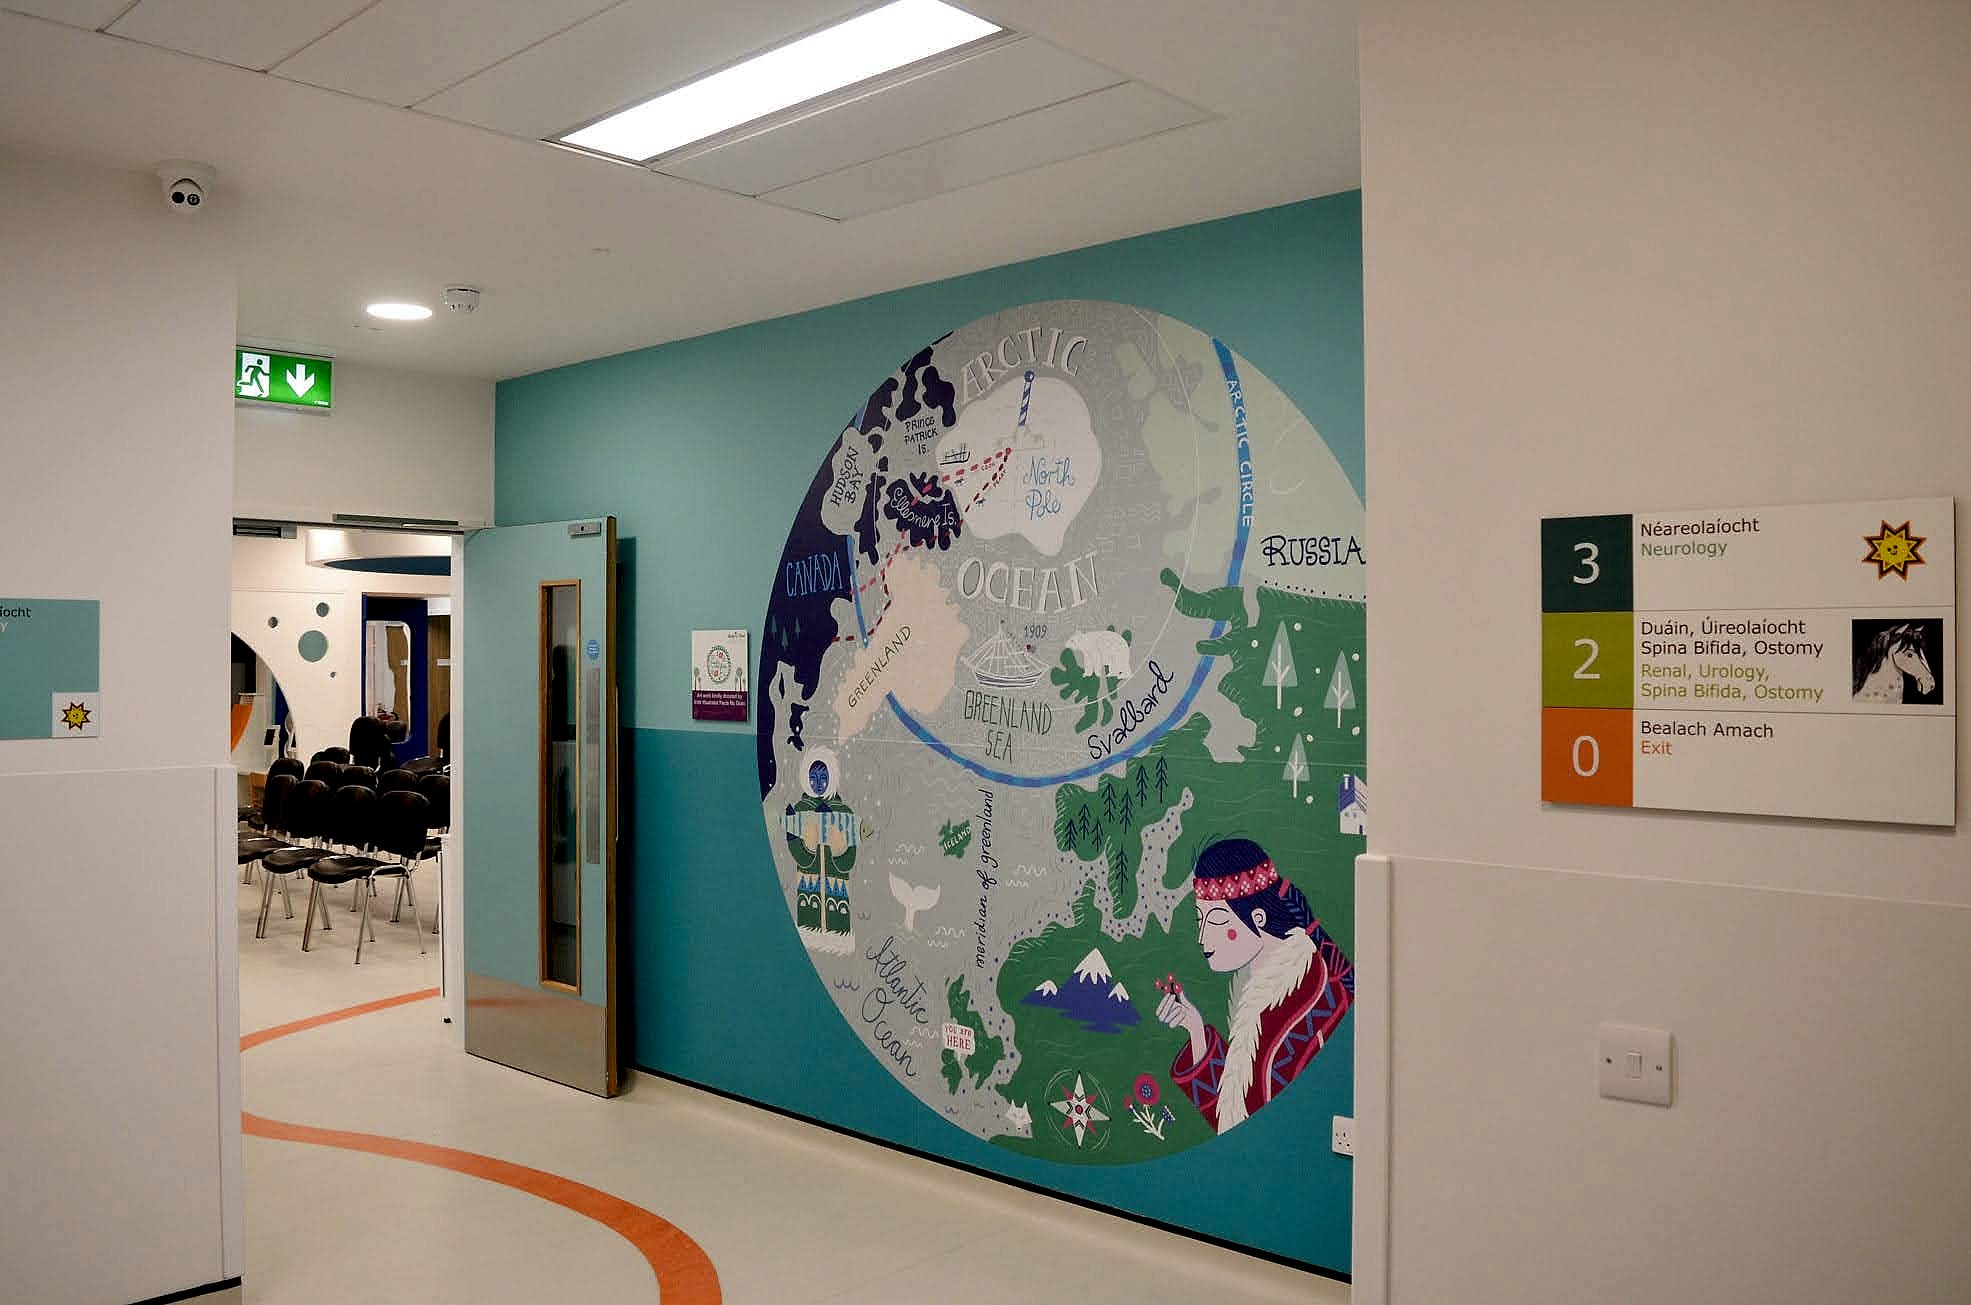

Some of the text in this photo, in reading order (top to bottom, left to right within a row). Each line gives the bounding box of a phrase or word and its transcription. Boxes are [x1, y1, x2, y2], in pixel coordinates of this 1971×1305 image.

[958, 326, 1089, 403] ARCTIC
[904, 427, 939, 445] PATRICK
[905, 416, 935, 432] PRINCE
[1227, 380, 1256, 527] ARCTIC CIRCLE
[831, 446, 860, 507] HUDSON
[844, 464, 864, 504] BAY
[1022, 456, 1075, 488] North
[1025, 488, 1062, 520] Pole
[1640, 518, 1761, 537] Néareolaíocht
[1261, 534, 1366, 566] RUSSIA
[1572, 542, 1600, 585] 3
[1640, 541, 1728, 557] Neurology
[785, 551, 844, 596] CANADA
[957, 552, 1100, 614] OCEAN
[1024, 624, 1048, 641] 1909
[1641, 617, 1806, 637] Duáin, Úireolaíocht
[1572, 638, 1601, 680] 2
[1641, 640, 1824, 657] Spina Bifida, Ostomy
[847, 624, 914, 709] GREENLAND
[1641, 664, 1770, 682] Renal, Urology,
[1641, 684, 1824, 702] Spina Bifida, Ostomy
[964, 689, 1053, 737] GREENLAND
[1087, 660, 1175, 761] Svalbard
[1641, 720, 1774, 738] Bealach Amach
[985, 730, 1014, 764] SEA
[1571, 735, 1600, 777] 0
[1641, 740, 1673, 755] Exit
[943, 826, 971, 850] ICELAND
[976, 788, 1000, 969] meridian of greenland
[865, 936, 929, 1024] Atlantic
[861, 987, 917, 1077] Ocean
[944, 1024, 957, 1034] YOU
[947, 1035, 971, 1050] HERE
